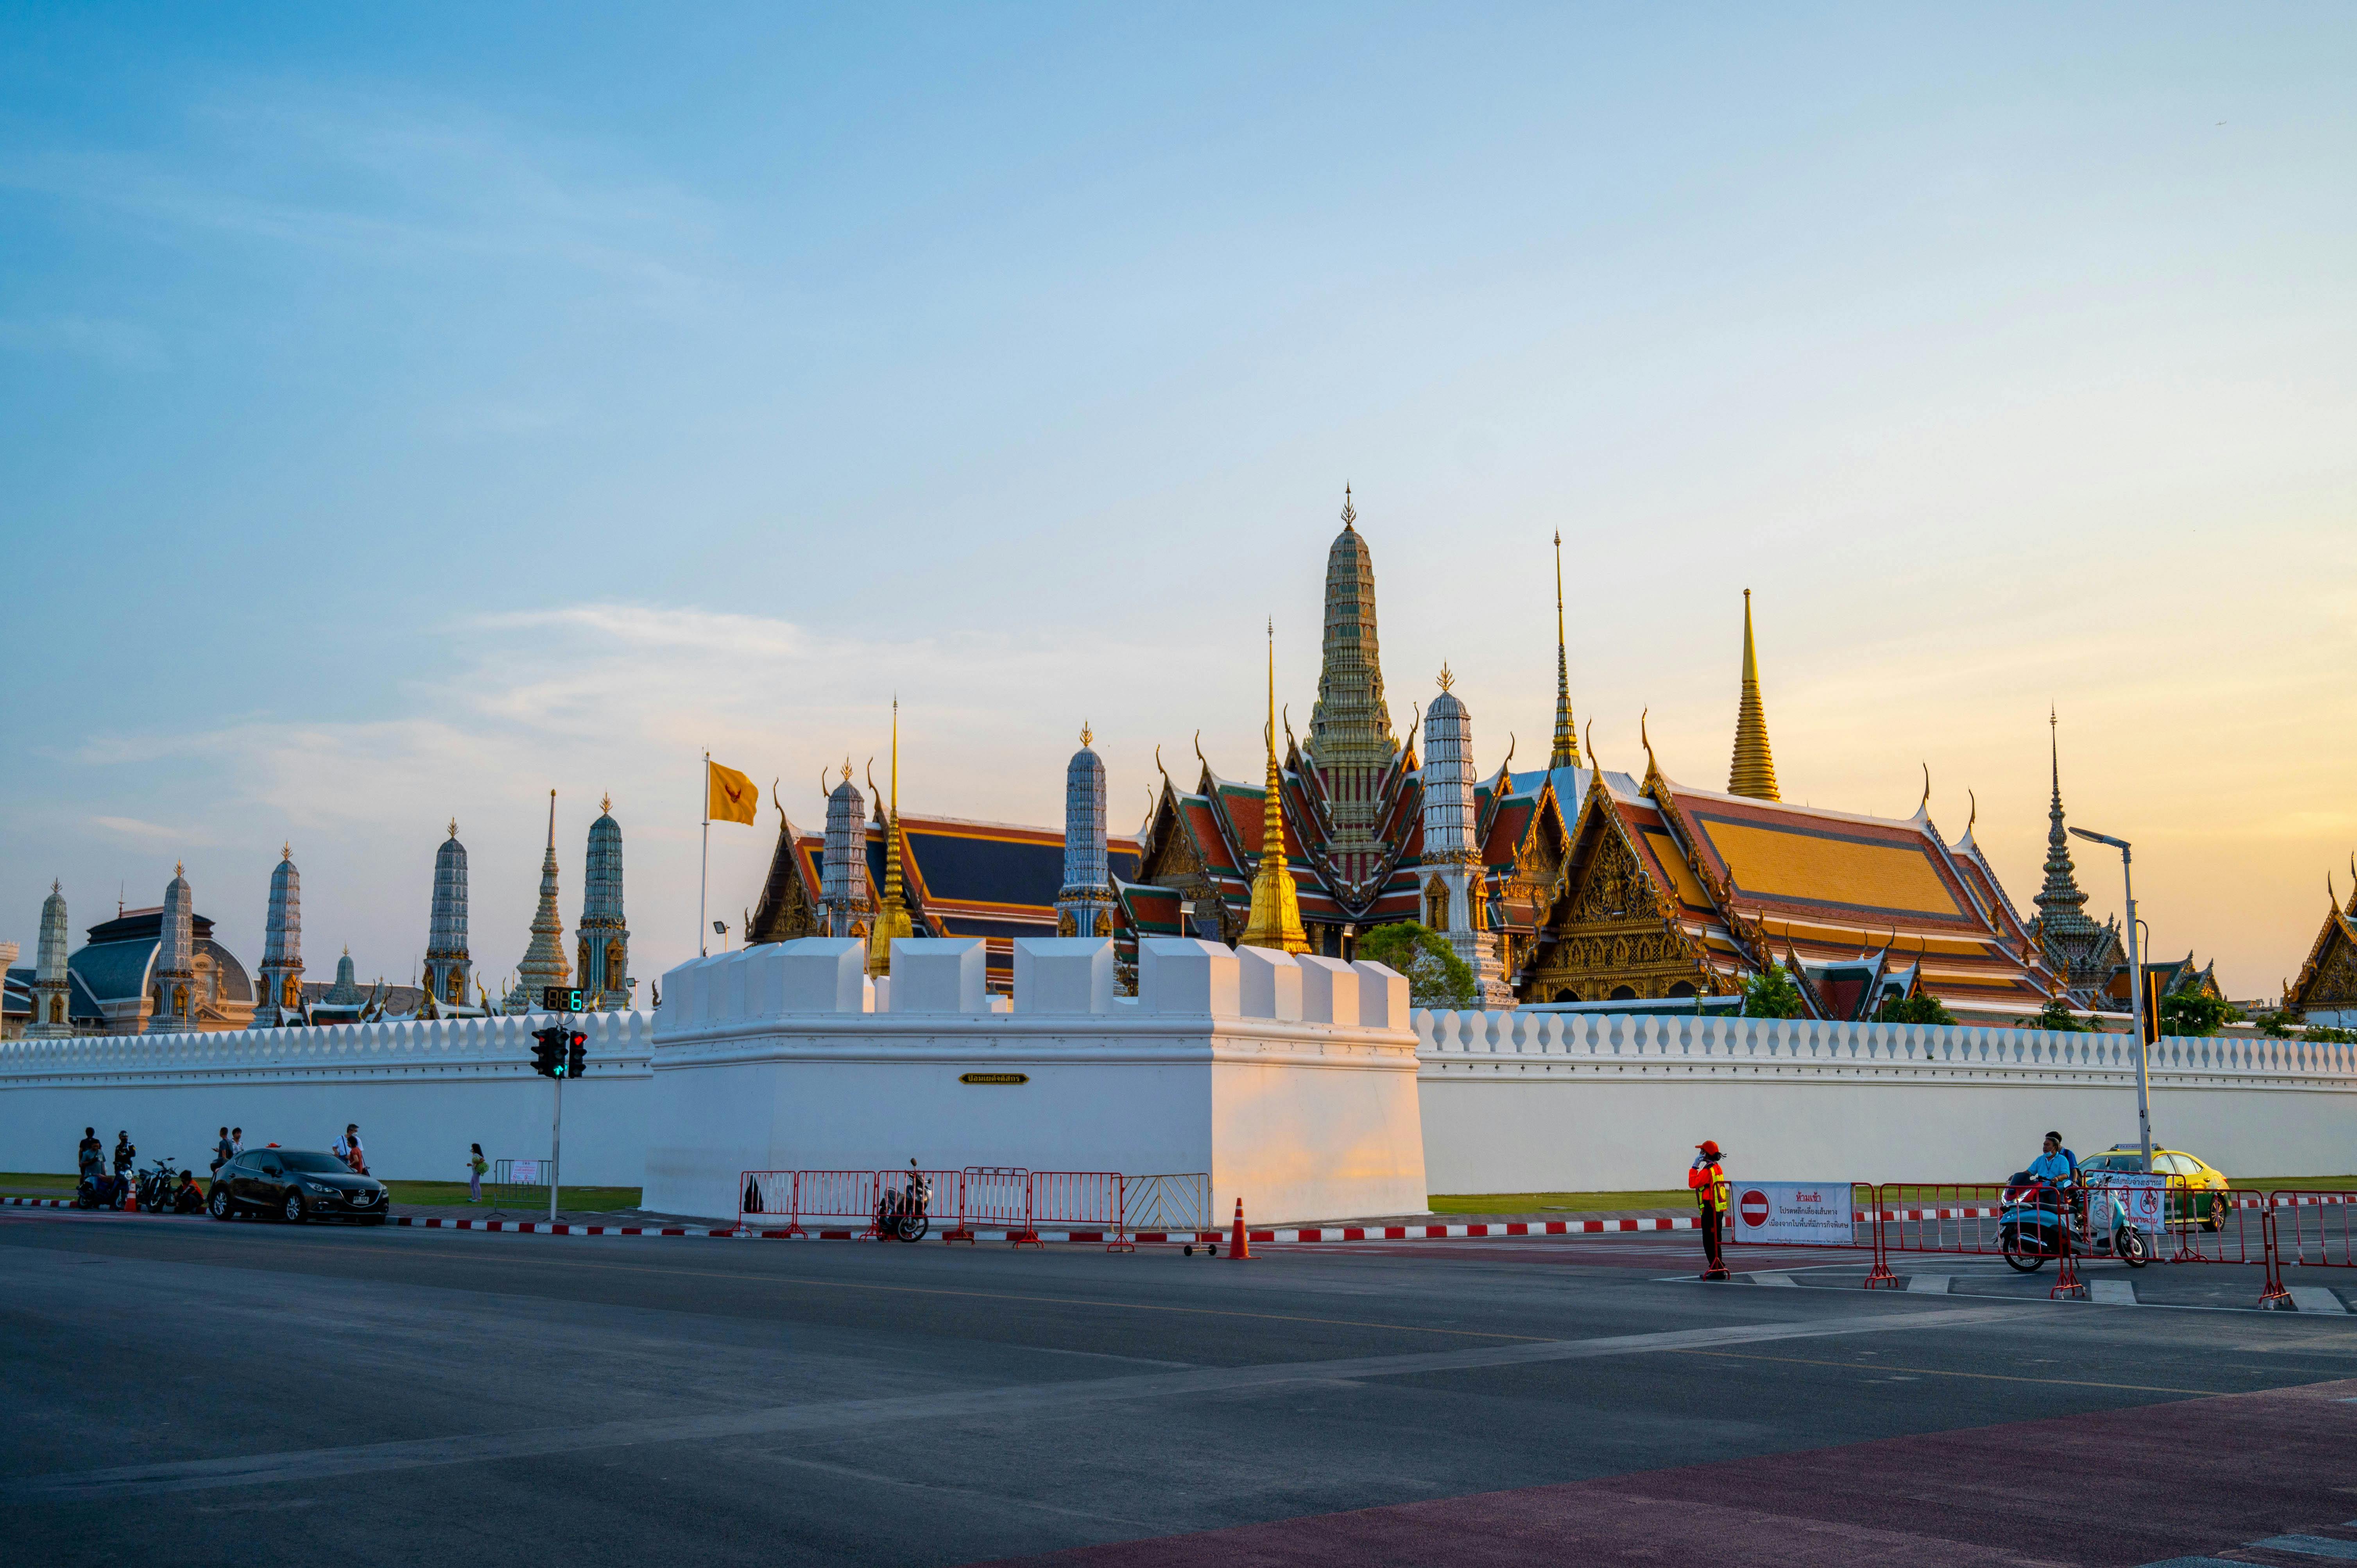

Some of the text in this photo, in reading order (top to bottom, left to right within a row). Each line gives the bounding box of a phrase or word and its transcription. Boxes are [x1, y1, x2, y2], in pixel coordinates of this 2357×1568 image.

[2140, 1110, 2145, 1119] 4
[2147, 1124, 2151, 1133] 4
[1796, 1191, 1821, 1201] ห้ามเข้า
[1779, 1205, 1838, 1215] โปรดหลีกเลี่ยงเส้นทาง
[1769, 1217, 1848, 1228] เนื่องจากในพื้นที่มีภารกิจพิเศษ
